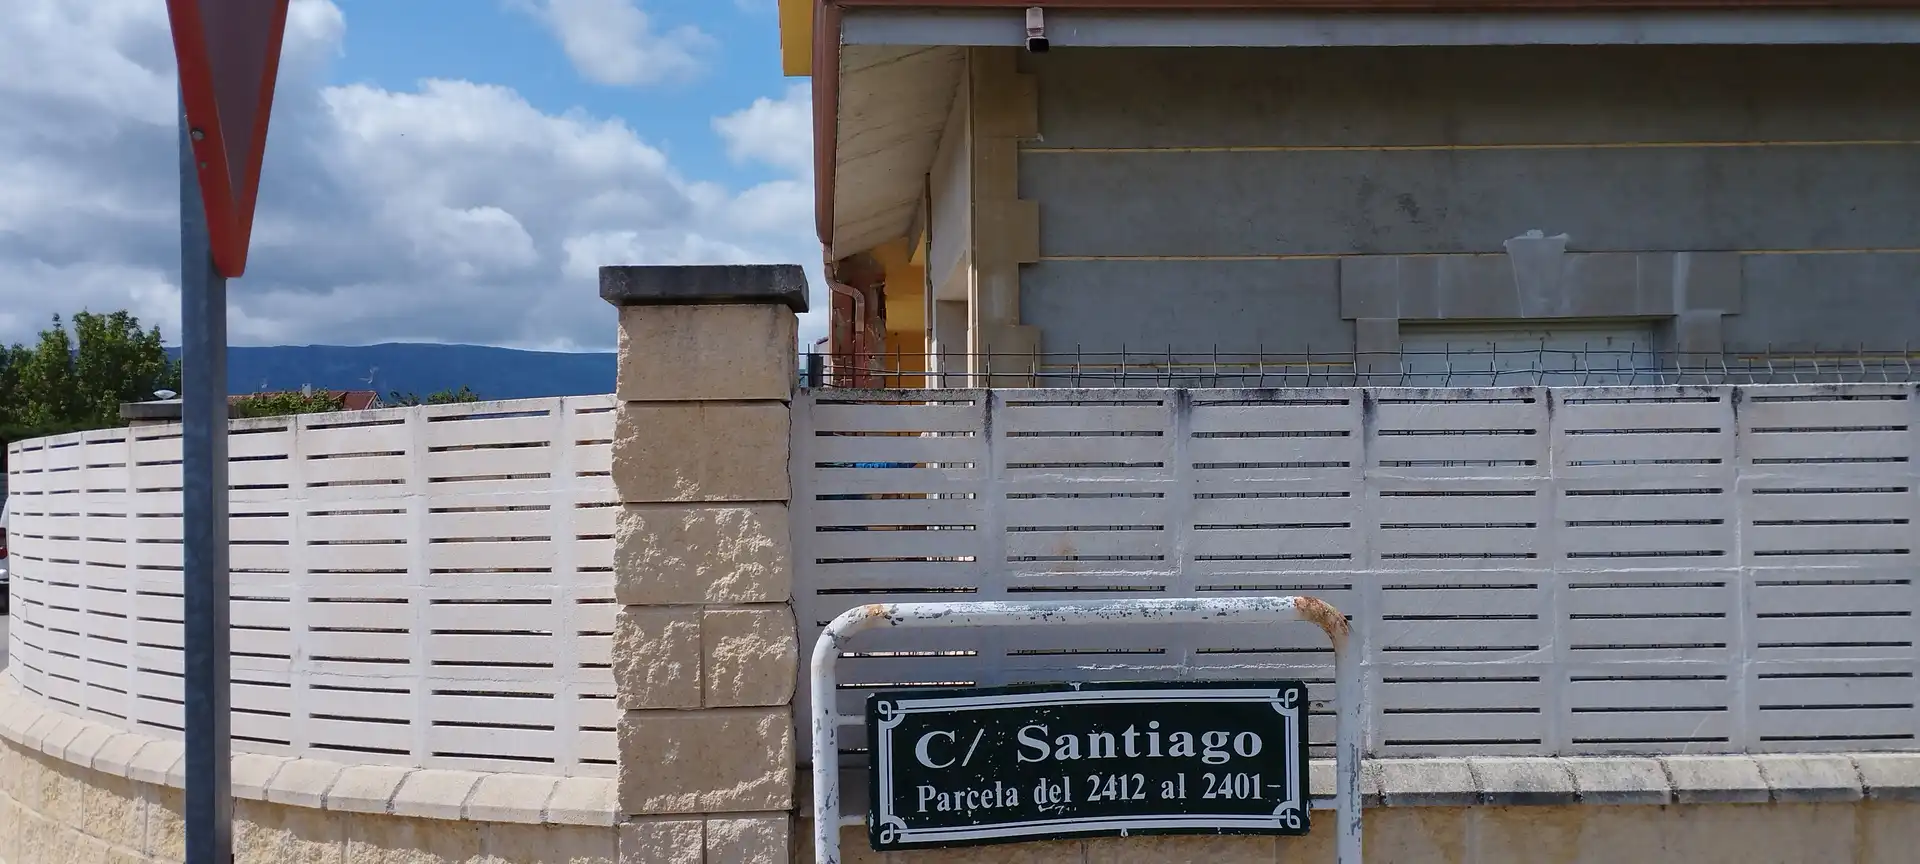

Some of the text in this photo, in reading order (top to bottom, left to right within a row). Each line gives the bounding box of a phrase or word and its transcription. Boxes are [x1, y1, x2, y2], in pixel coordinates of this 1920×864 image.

[914, 720, 1263, 769] C/ Santiago
[916, 780, 1020, 813] Parcela
[1034, 776, 1071, 804] del
[1086, 773, 1147, 802] 2412
[1161, 773, 1187, 800] al
